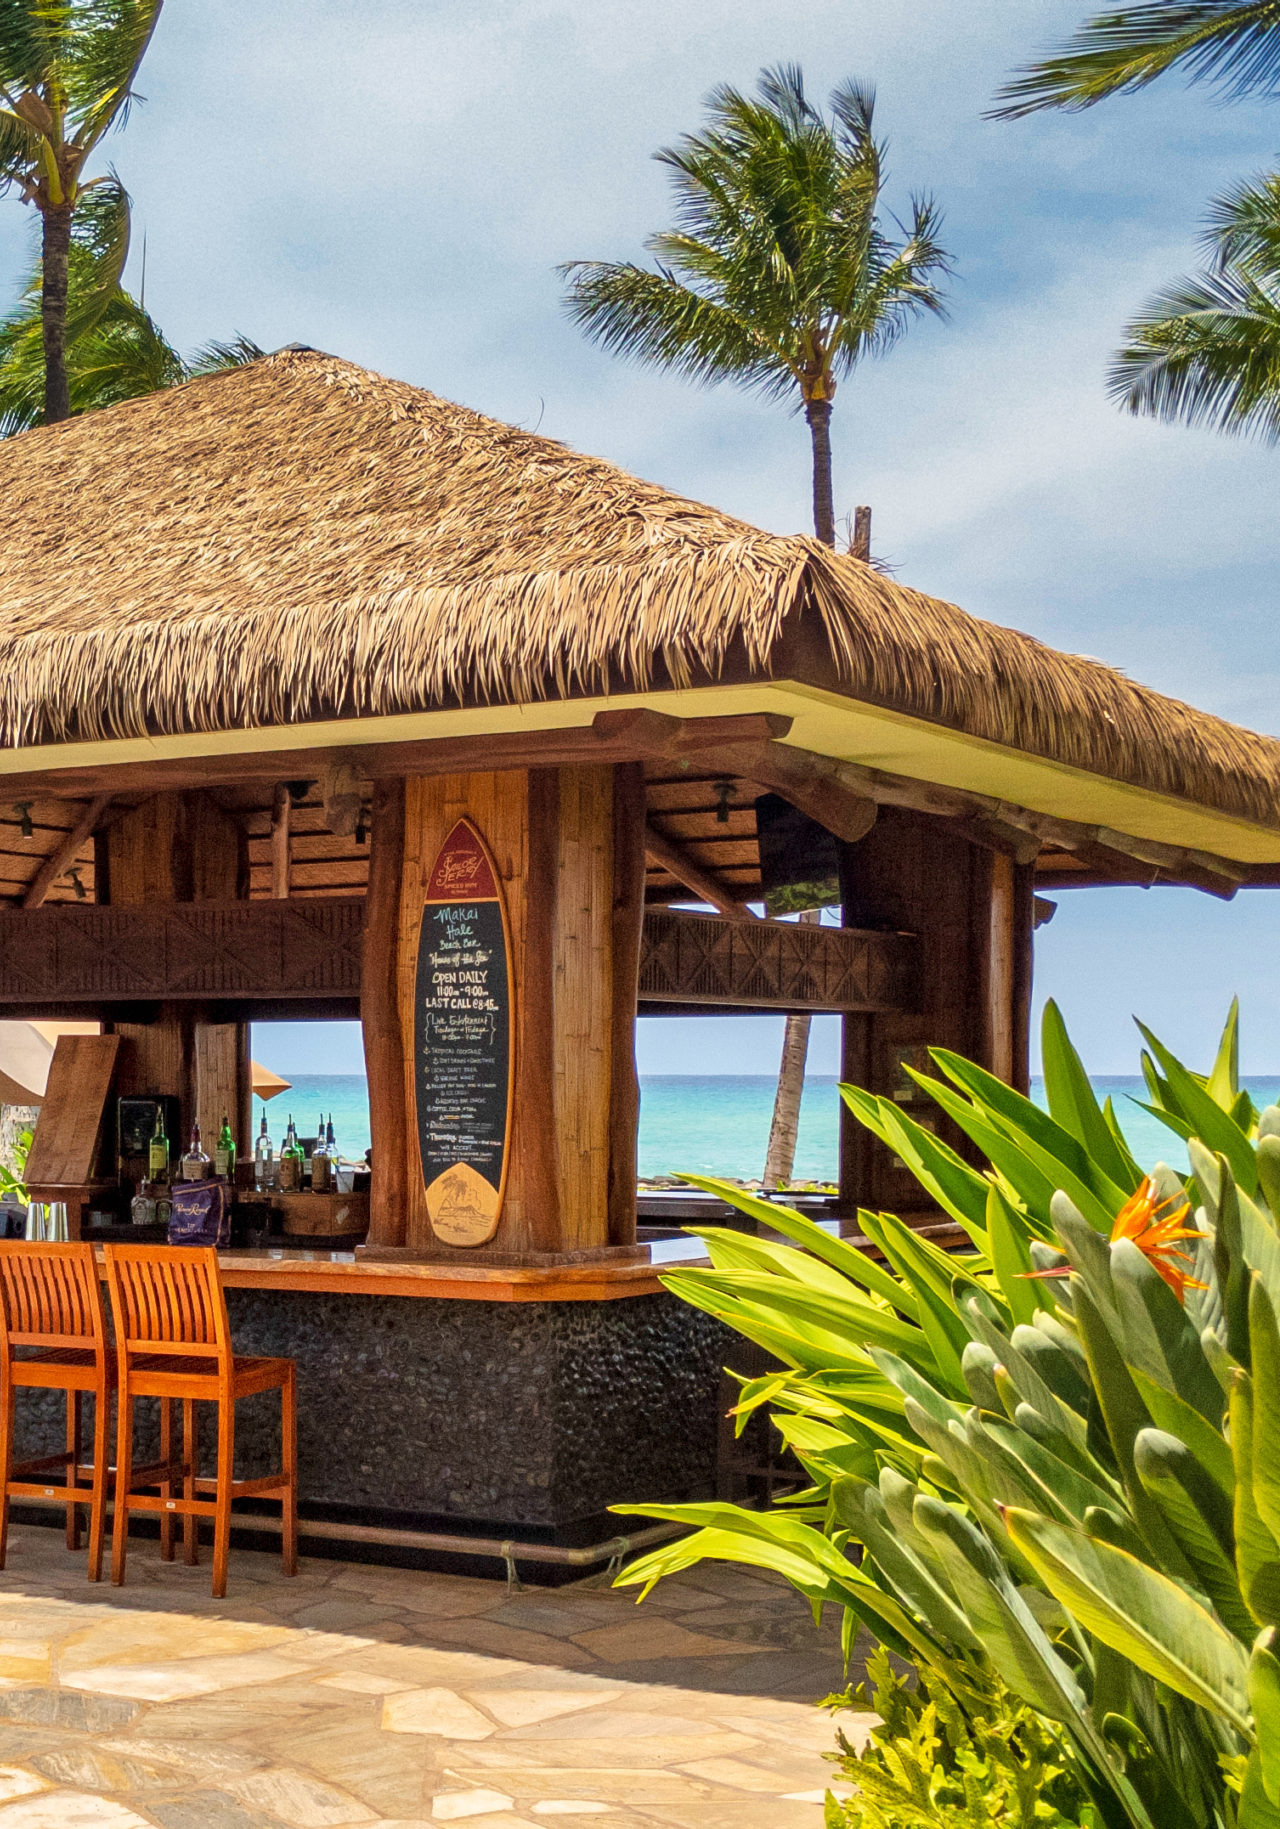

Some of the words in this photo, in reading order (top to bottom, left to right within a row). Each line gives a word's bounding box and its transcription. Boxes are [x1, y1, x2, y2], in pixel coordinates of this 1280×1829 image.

[433, 907, 478, 923] Makai
[446, 924, 473, 940] Hale
[432, 972, 456, 985] OPEN
[459, 970, 488, 983] DAILY
[426, 998, 449, 1008] LAST
[451, 998, 471, 1009] CALL
